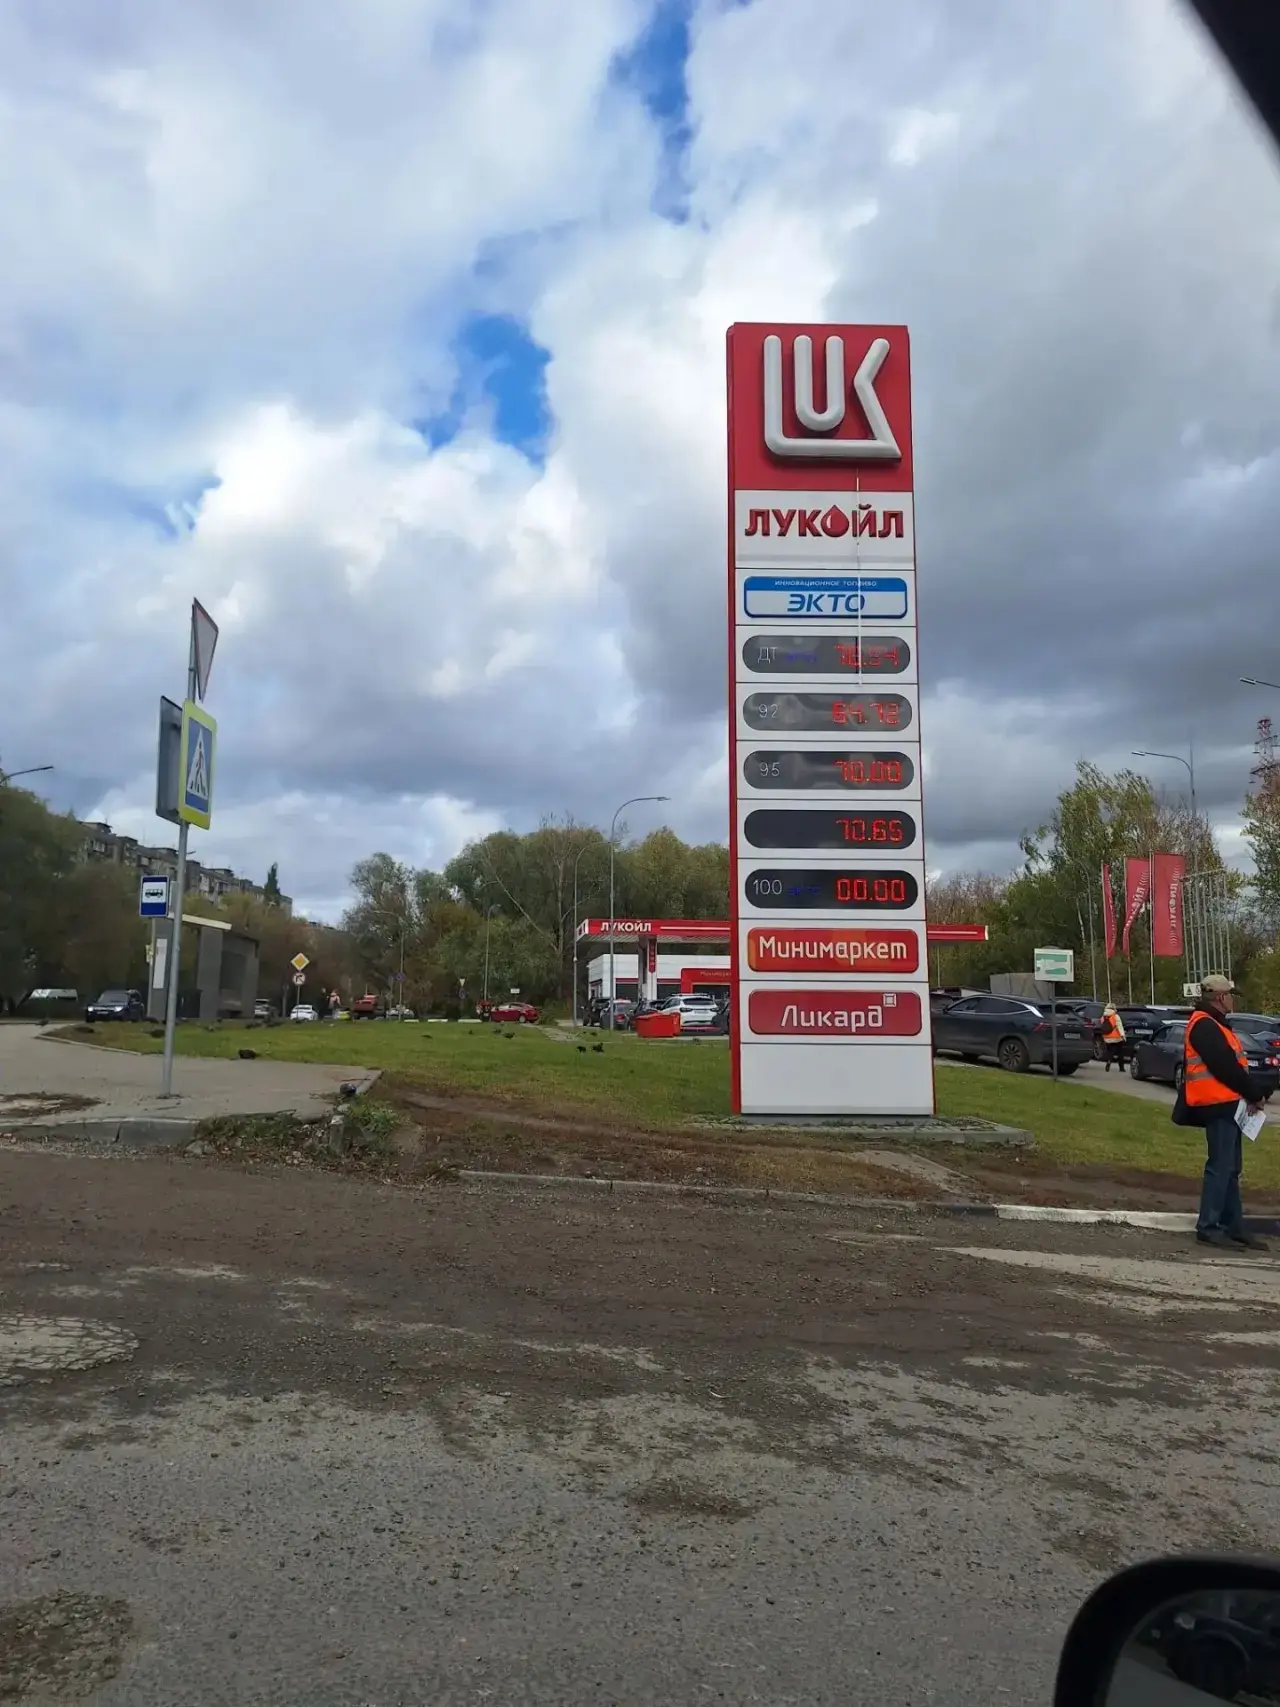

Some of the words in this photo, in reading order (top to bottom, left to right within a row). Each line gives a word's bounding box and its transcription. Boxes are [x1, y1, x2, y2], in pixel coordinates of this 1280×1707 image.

[744, 503, 904, 538] ЛУКОЙЛ
[774, 580, 840, 588] ИННОВАЦИОННОЕ
[787, 593, 866, 613] ЭКТО
[757, 646, 778, 664] ДТ
[758, 703, 778, 719] 92
[832, 702, 899, 725] 64.72
[760, 761, 781, 777] 95
[834, 760, 902, 783] 70.00
[835, 818, 903, 842] 70.65
[752, 879, 783, 896] 100
[836, 878, 906, 902] 00.00
[600, 920, 652, 932] ЛУКОЙЛ
[758, 935, 907, 965] Минимаркет
[780, 1004, 883, 1032] Ликард
